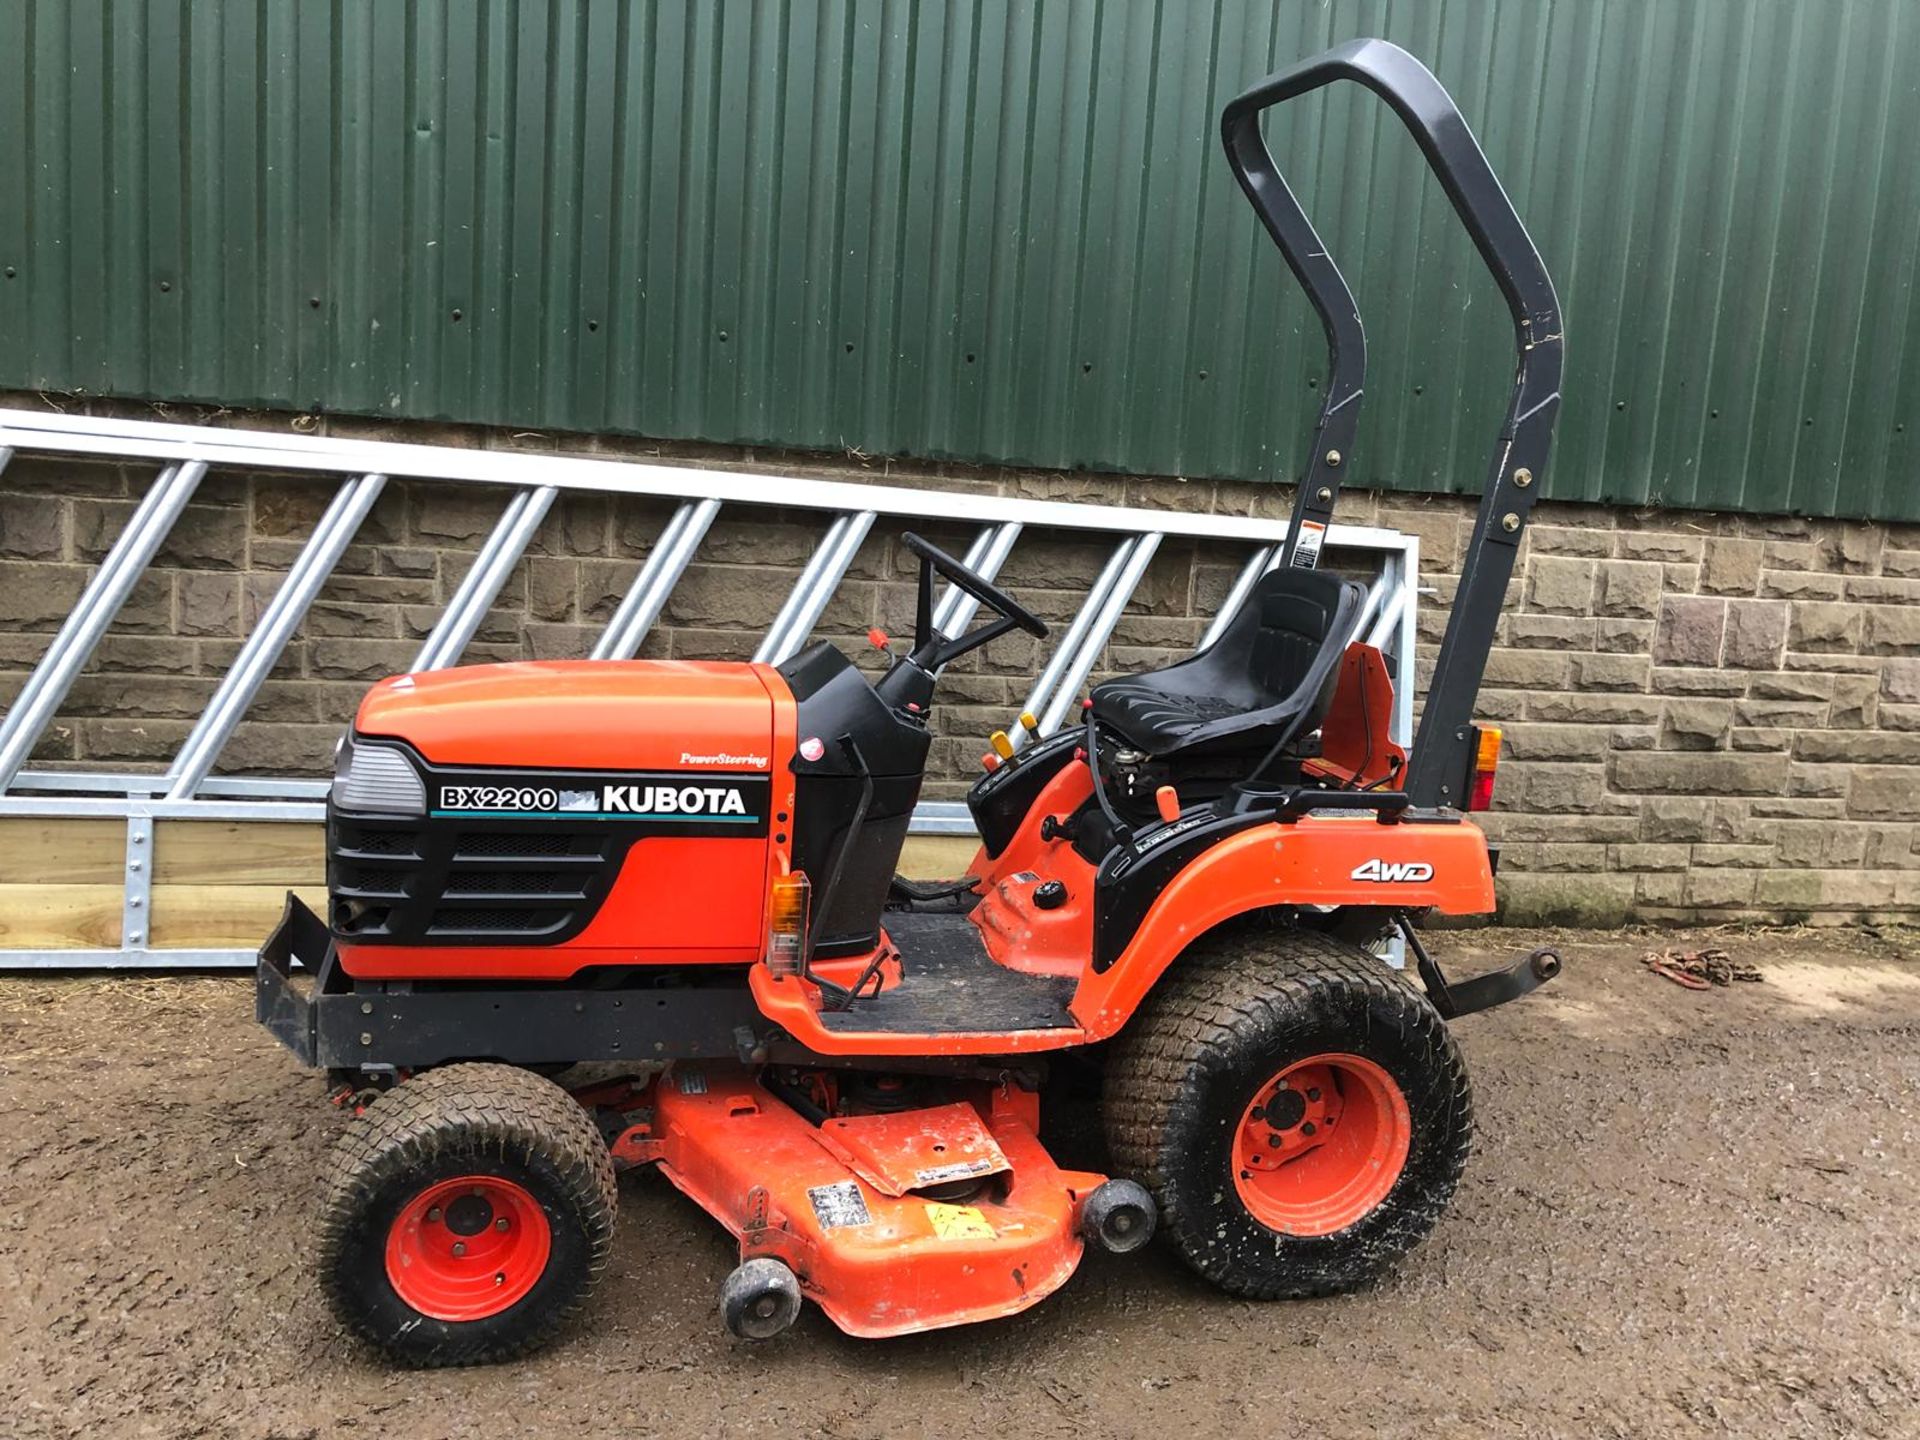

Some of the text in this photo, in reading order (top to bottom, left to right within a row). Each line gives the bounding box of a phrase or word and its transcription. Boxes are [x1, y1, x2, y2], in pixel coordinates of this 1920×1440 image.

[680, 752, 767, 768] PowerSteering
[440, 786, 746, 814] BX2200 KUBOTA
[1351, 858, 1434, 882] 4WD
